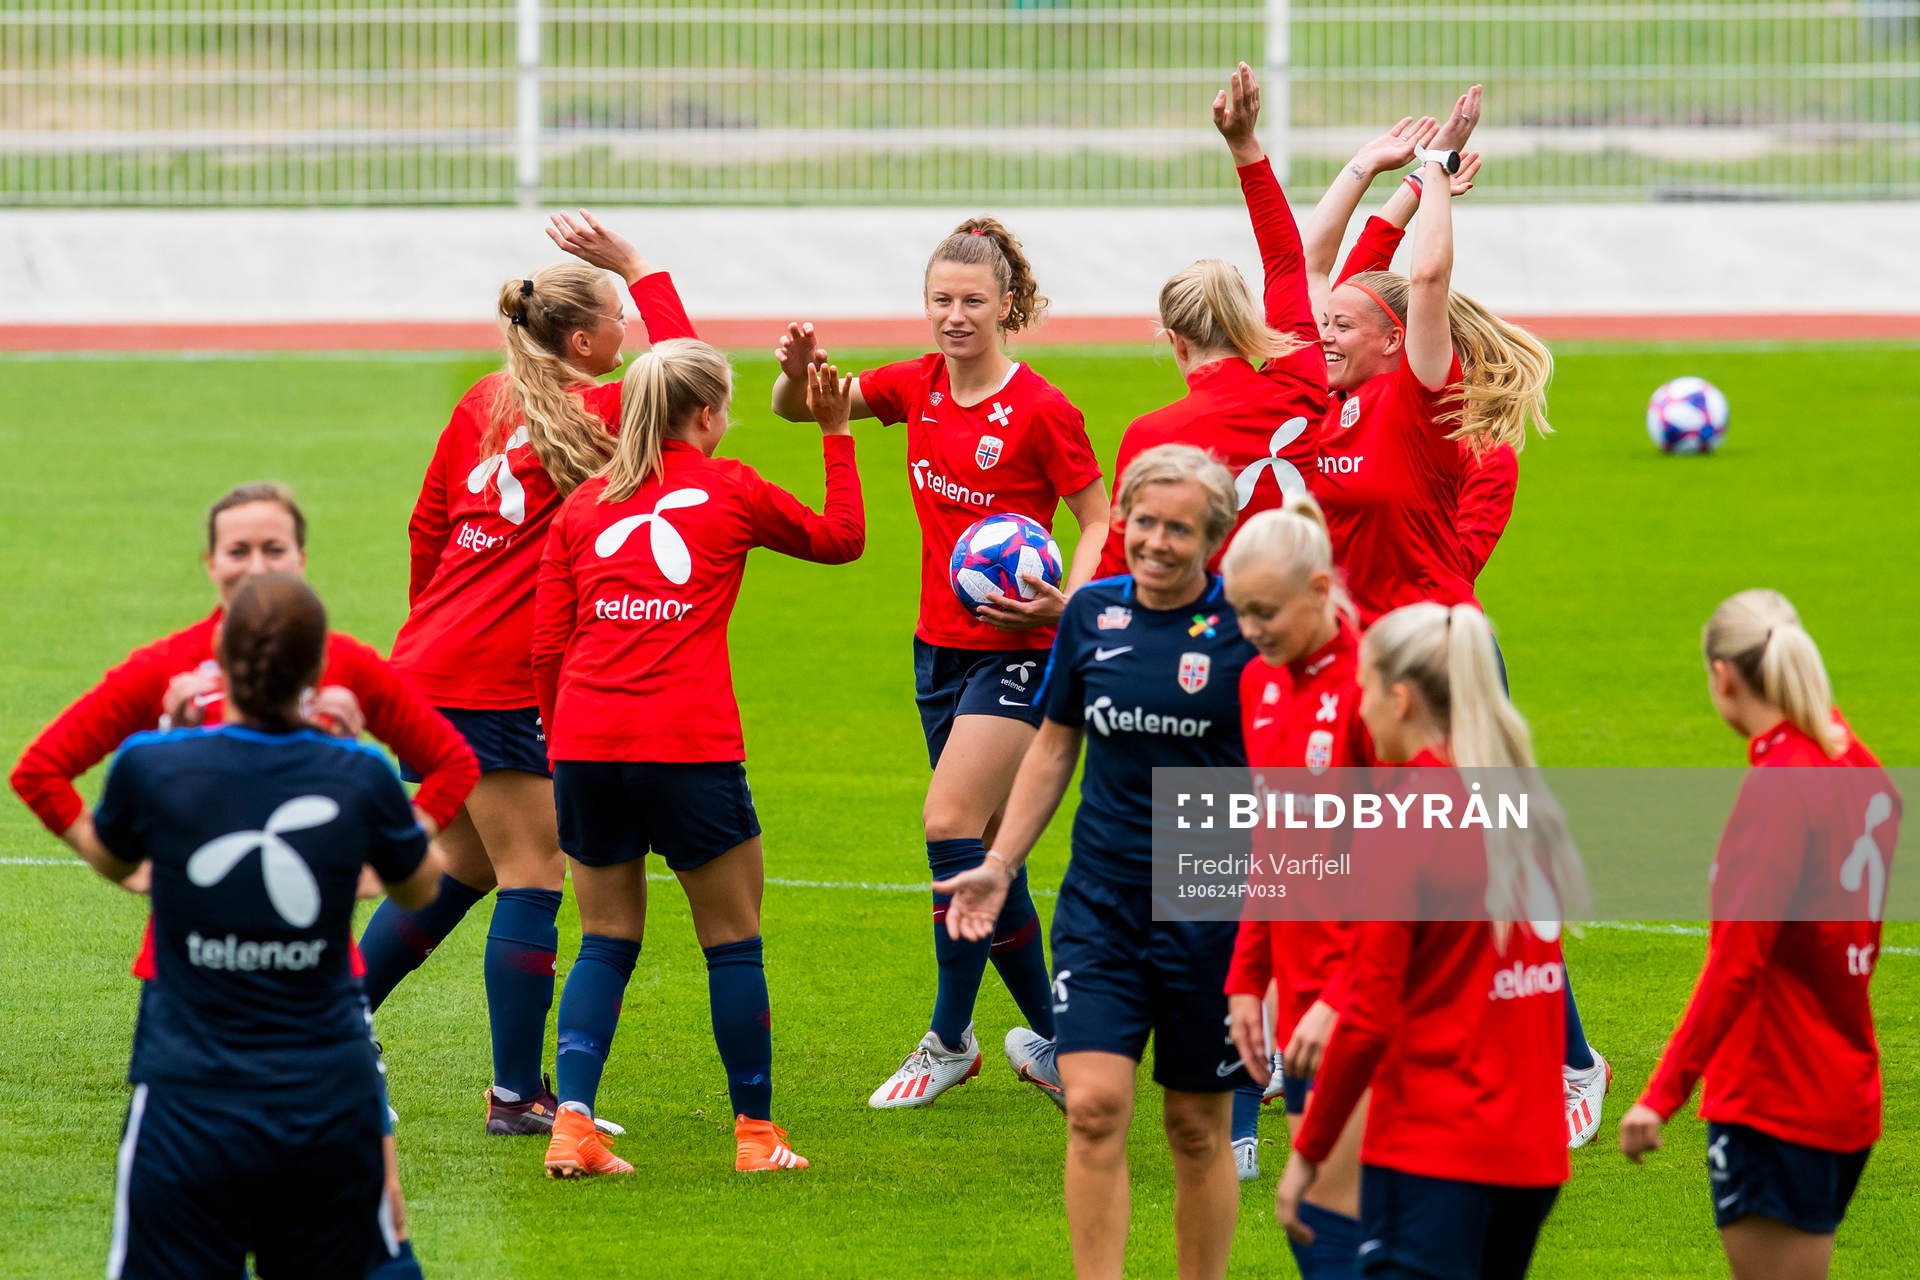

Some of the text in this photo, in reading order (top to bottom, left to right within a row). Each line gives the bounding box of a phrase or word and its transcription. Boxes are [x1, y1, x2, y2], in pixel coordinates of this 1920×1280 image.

[926, 469, 996, 507] telenor
[594, 593, 693, 622] telenor
[1107, 705, 1212, 738] telenor
[186, 931, 327, 971] telenor
